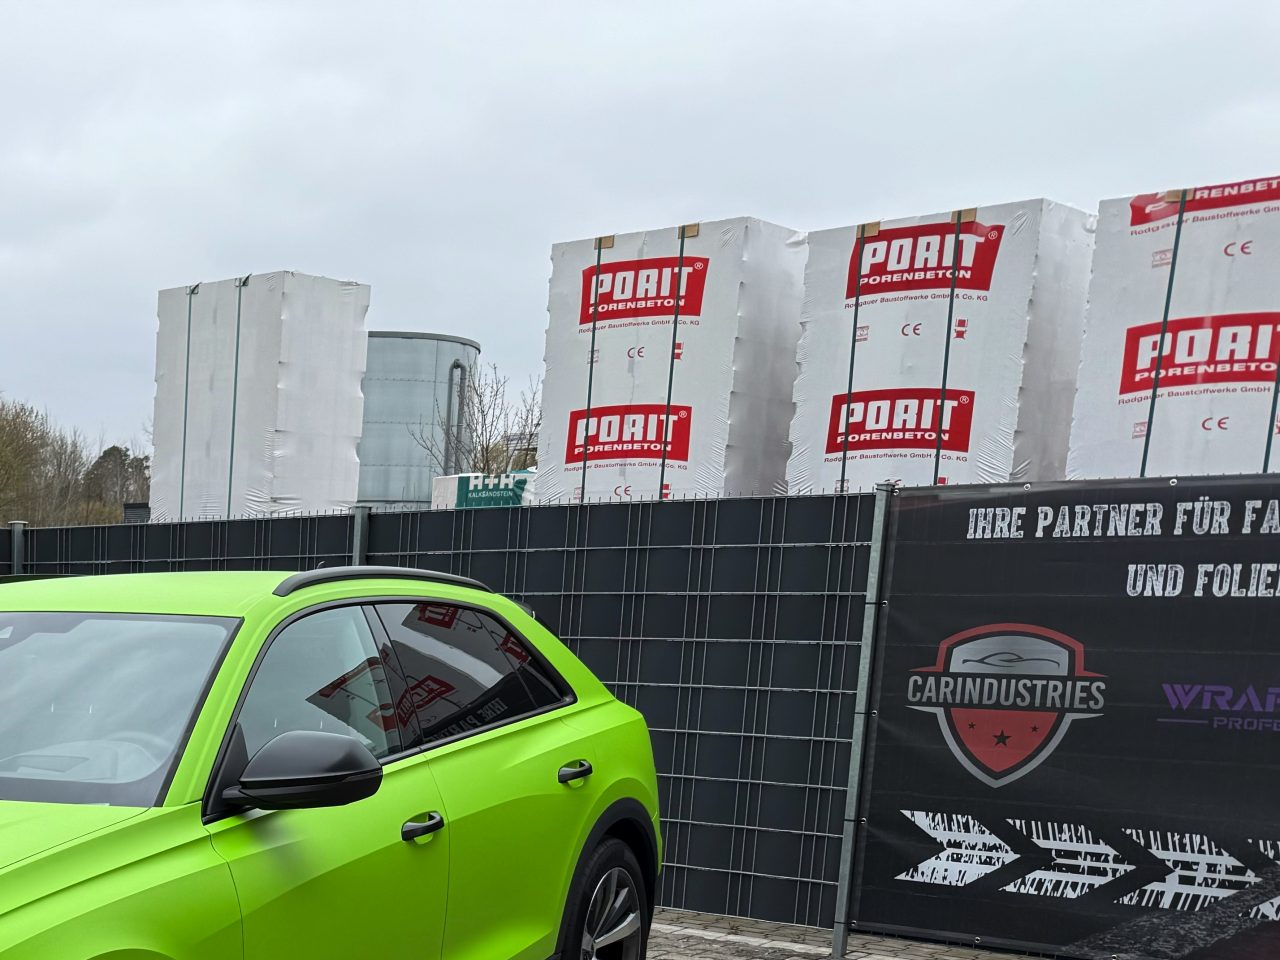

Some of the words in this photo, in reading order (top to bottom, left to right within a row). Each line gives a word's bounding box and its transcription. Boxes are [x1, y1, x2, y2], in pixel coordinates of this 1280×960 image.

[860, 233, 986, 275] PORIT
[589, 266, 694, 305] PORIT
[859, 269, 972, 287] PORENBETON
[844, 299, 878, 310] Rogauer
[1136, 324, 1280, 371] PORI
[1240, 385, 1271, 393] GmbH
[575, 413, 678, 446] PORIT
[837, 398, 959, 434] PORIT
[574, 443, 672, 455] PORENBETON
[467, 490, 514, 498] KALKSANDSTEIN
[966, 506, 1027, 539] IHRE
[1035, 502, 1164, 538] PARTNER
[1173, 496, 1232, 536] FÜR
[1241, 499, 1280, 535] FA
[1126, 563, 1185, 597] UND
[1193, 563, 1280, 597] FOLIE
[907, 674, 1108, 711] CARINDUSTRIES
